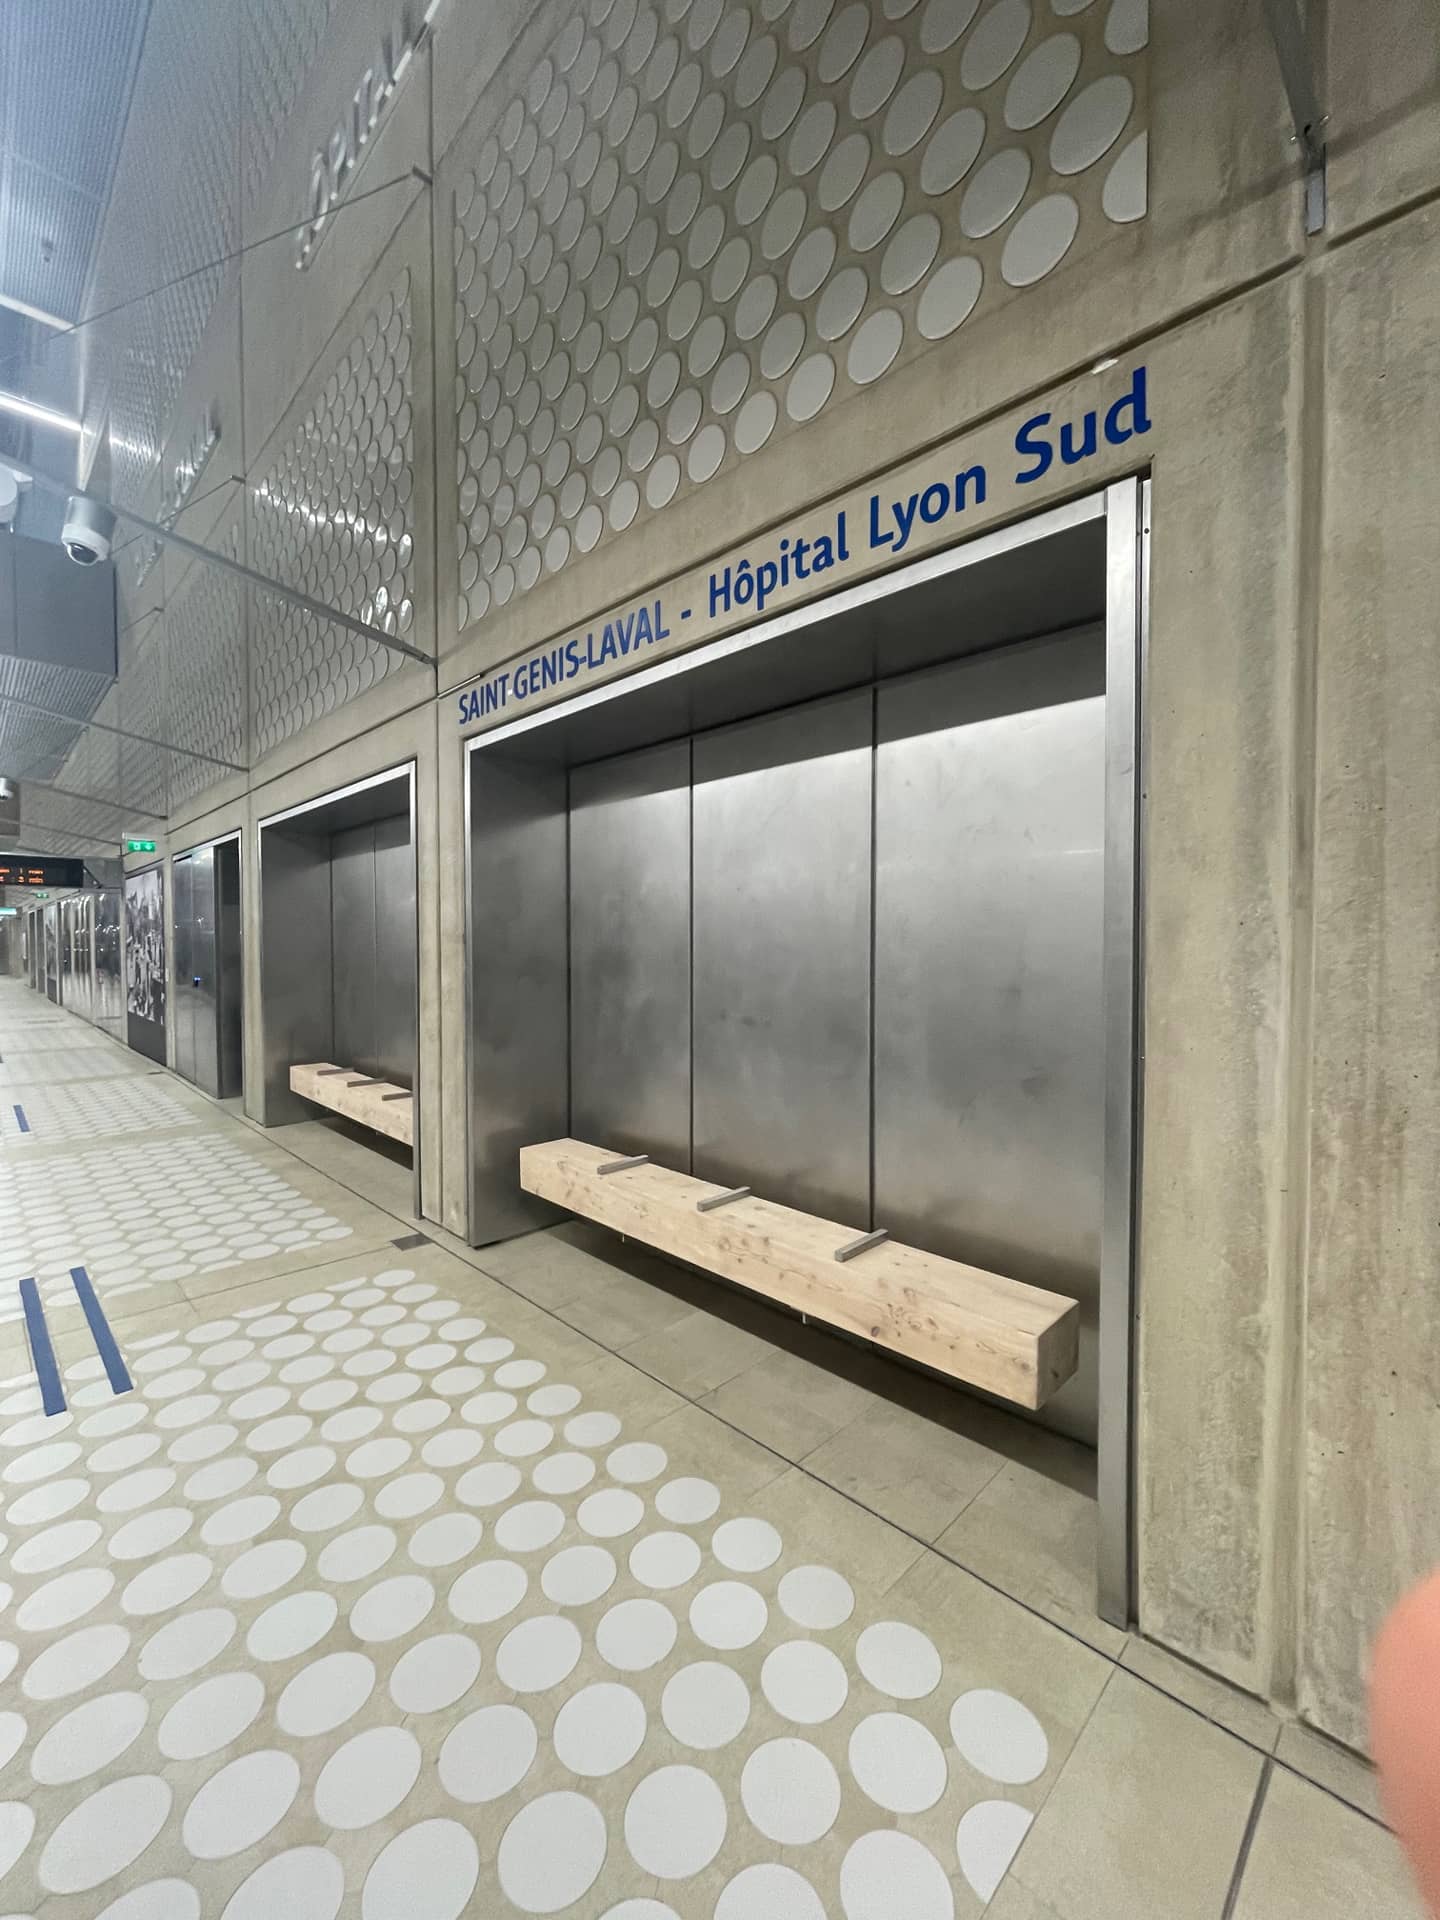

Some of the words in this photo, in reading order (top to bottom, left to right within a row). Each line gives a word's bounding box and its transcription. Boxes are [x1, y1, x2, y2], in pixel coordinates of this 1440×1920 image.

[681, 608, 692, 620] -
[710, 512, 849, 616] Hôpital
[871, 463, 986, 551] Lyon
[1016, 367, 1152, 483] Sud
